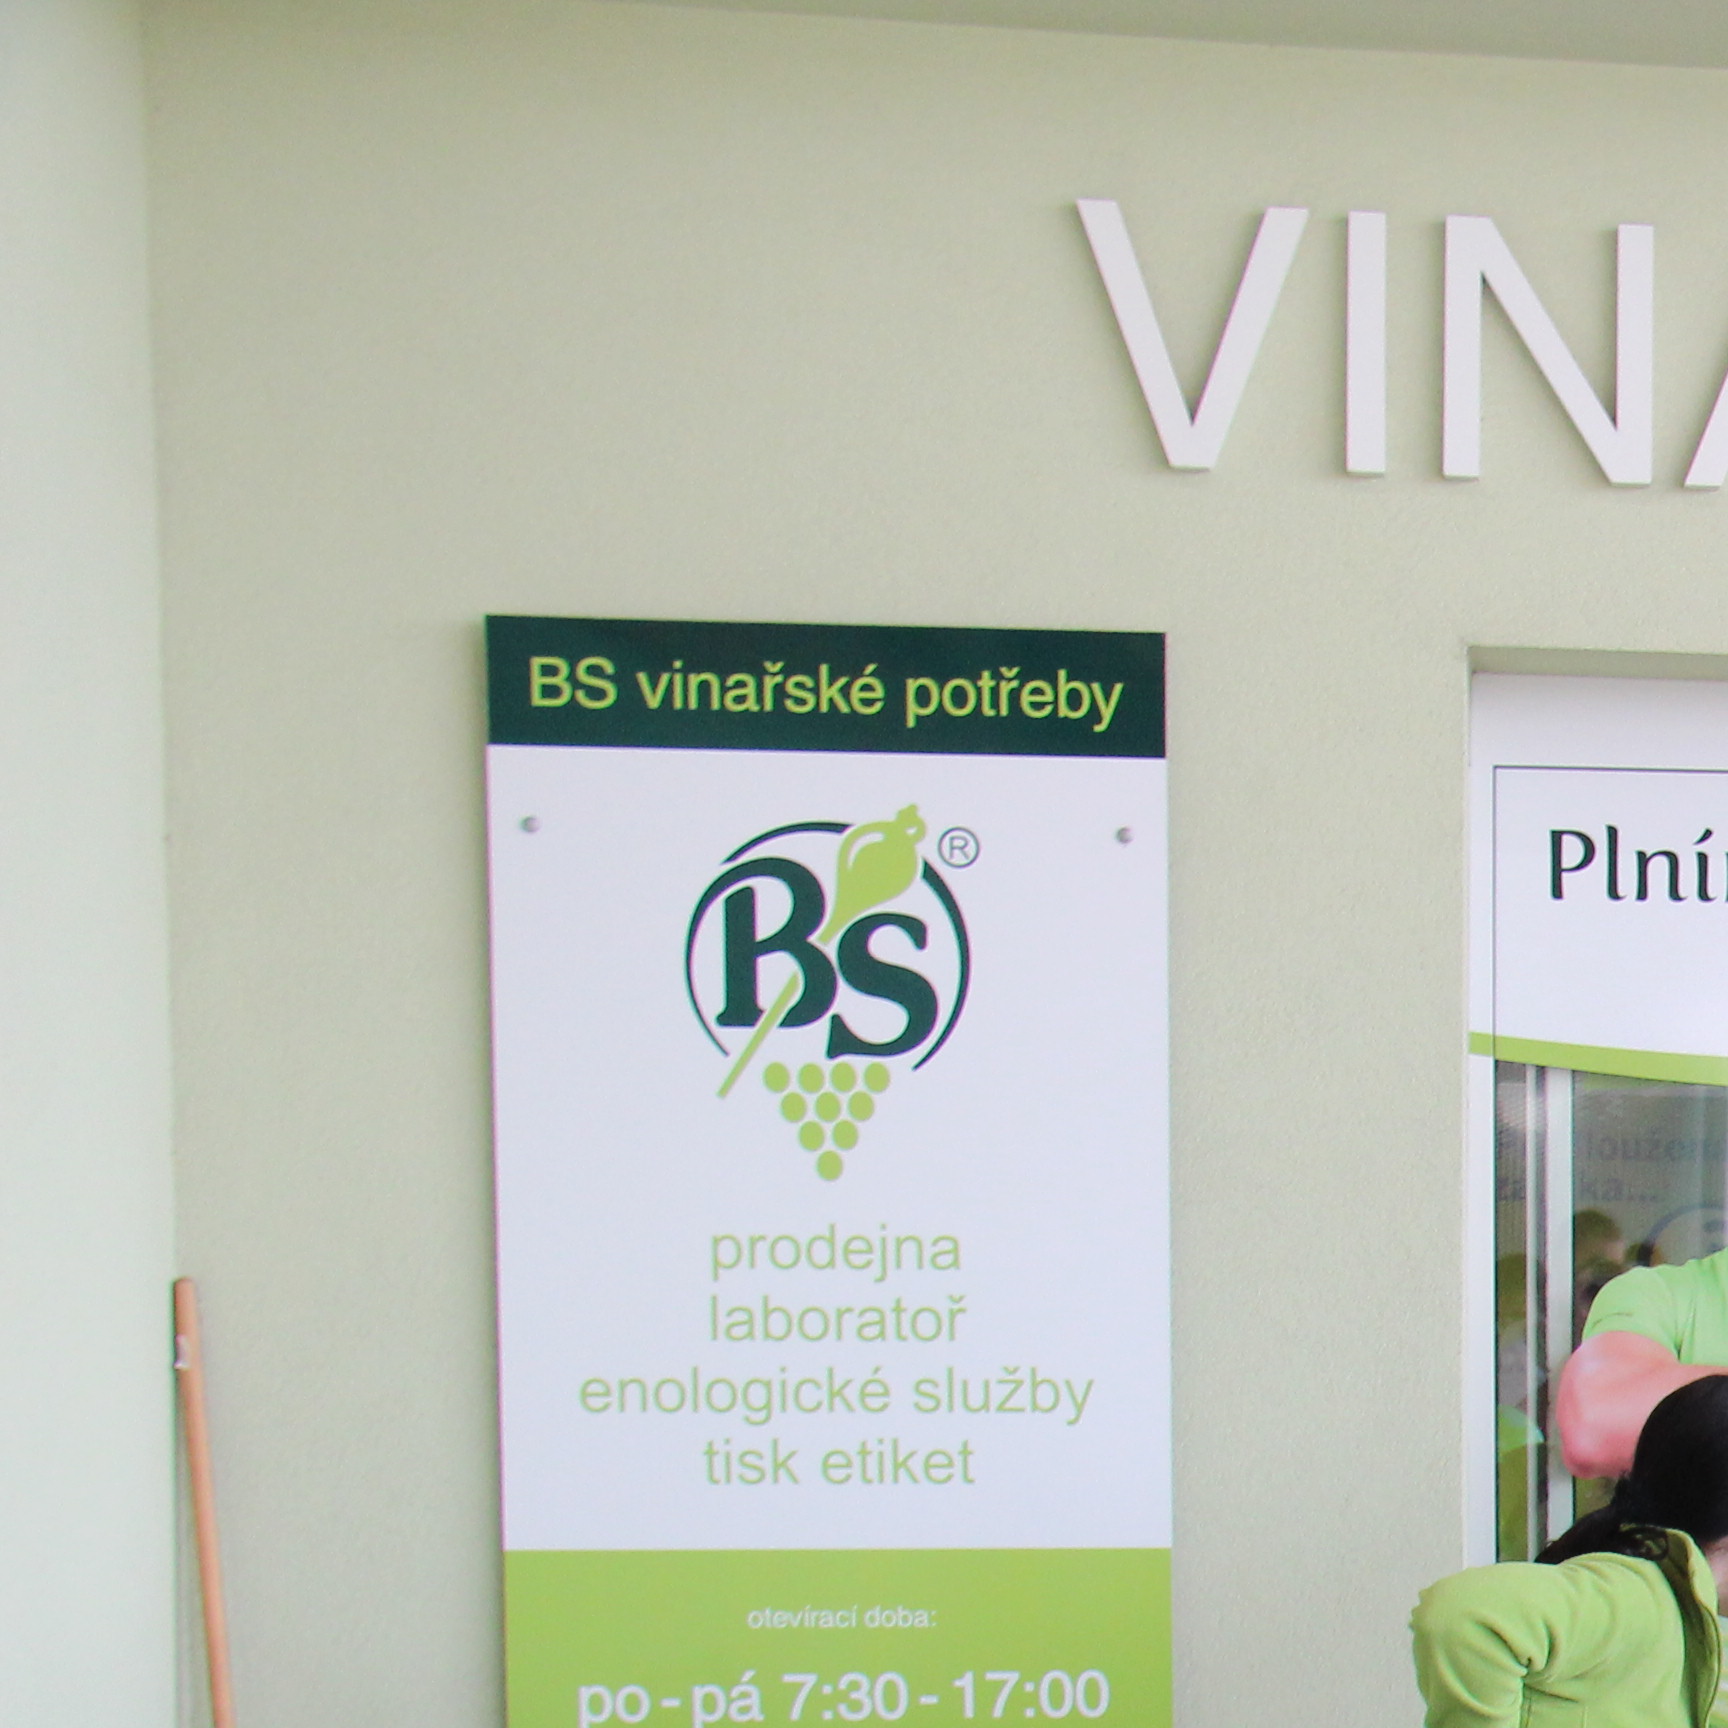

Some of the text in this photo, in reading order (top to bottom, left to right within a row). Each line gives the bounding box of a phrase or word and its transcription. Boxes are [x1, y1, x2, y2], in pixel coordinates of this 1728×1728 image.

[529, 656, 1124, 732] BS vinařské potřeby
[700, 857, 940, 1060] BS
[711, 1222, 962, 1282] prodejna
[709, 1295, 967, 1342] laboratoř
[579, 1366, 1095, 1425] enologické služby
[704, 1438, 976, 1485] tisk etiket
[747, 1605, 937, 1629] otevírací doba:
